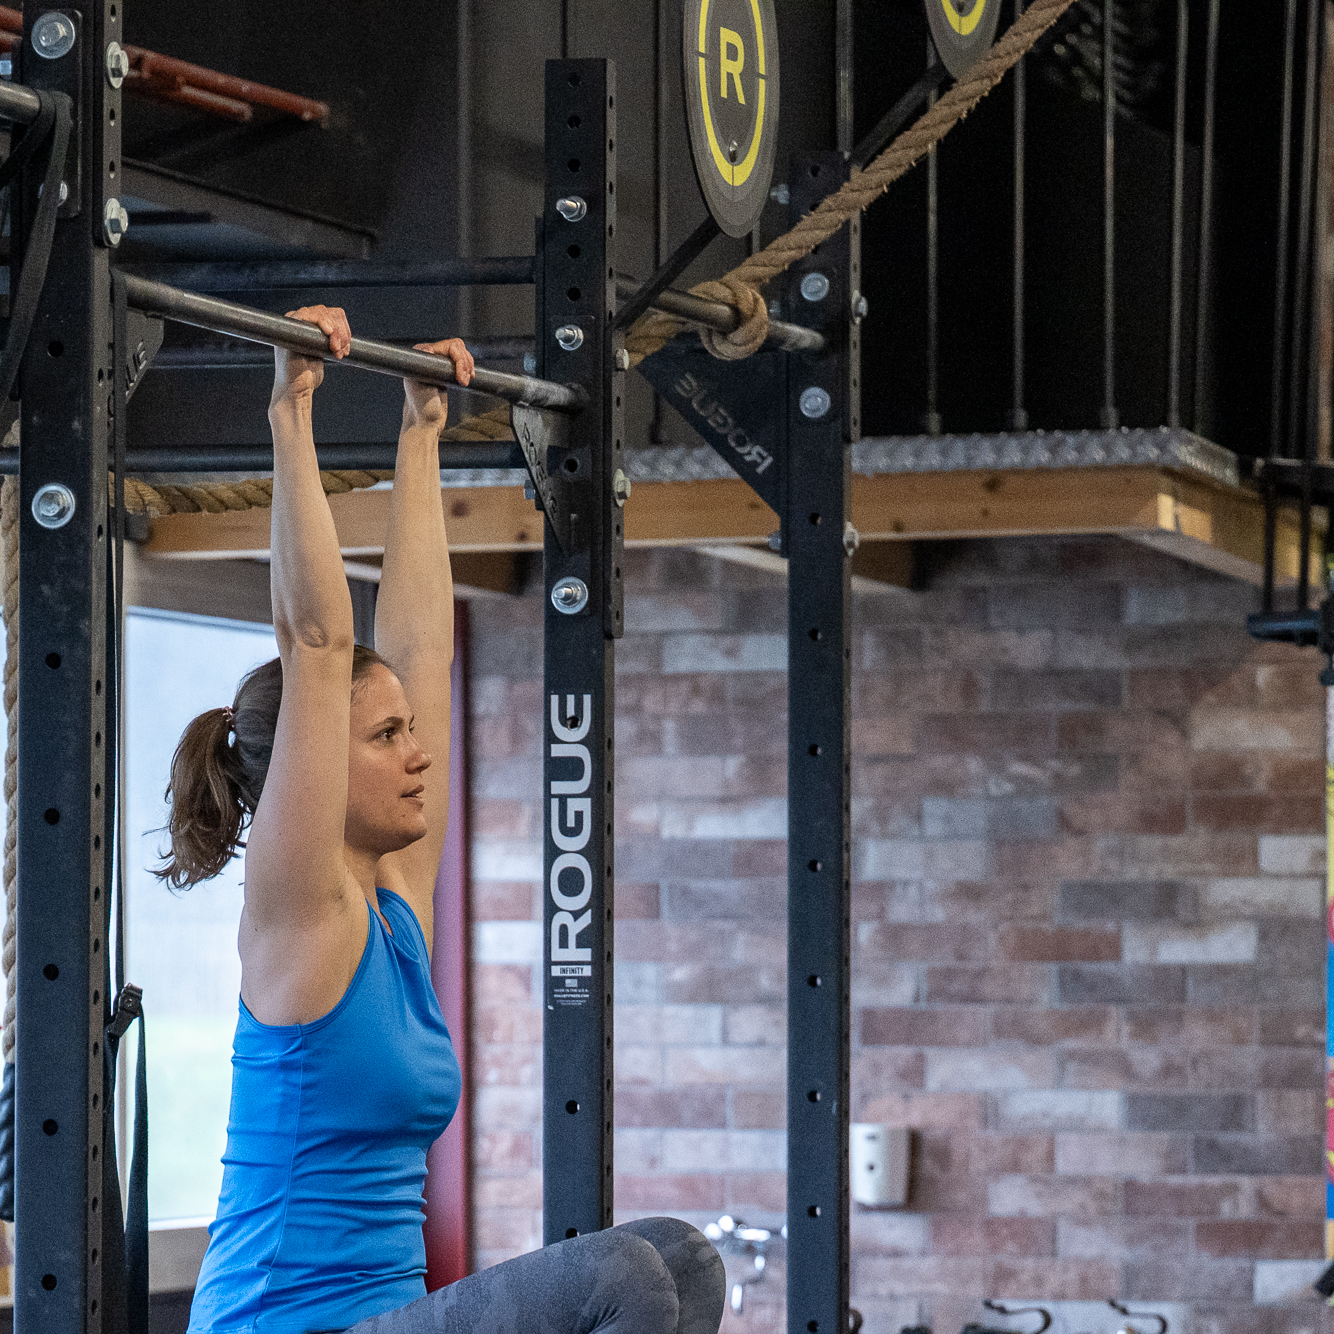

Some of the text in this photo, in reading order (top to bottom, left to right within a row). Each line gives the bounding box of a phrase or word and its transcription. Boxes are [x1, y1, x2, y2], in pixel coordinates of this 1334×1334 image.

[720, 27, 746, 105] R
[550, 694, 593, 962] ROGUE
[559, 966, 585, 975] INFINITY
